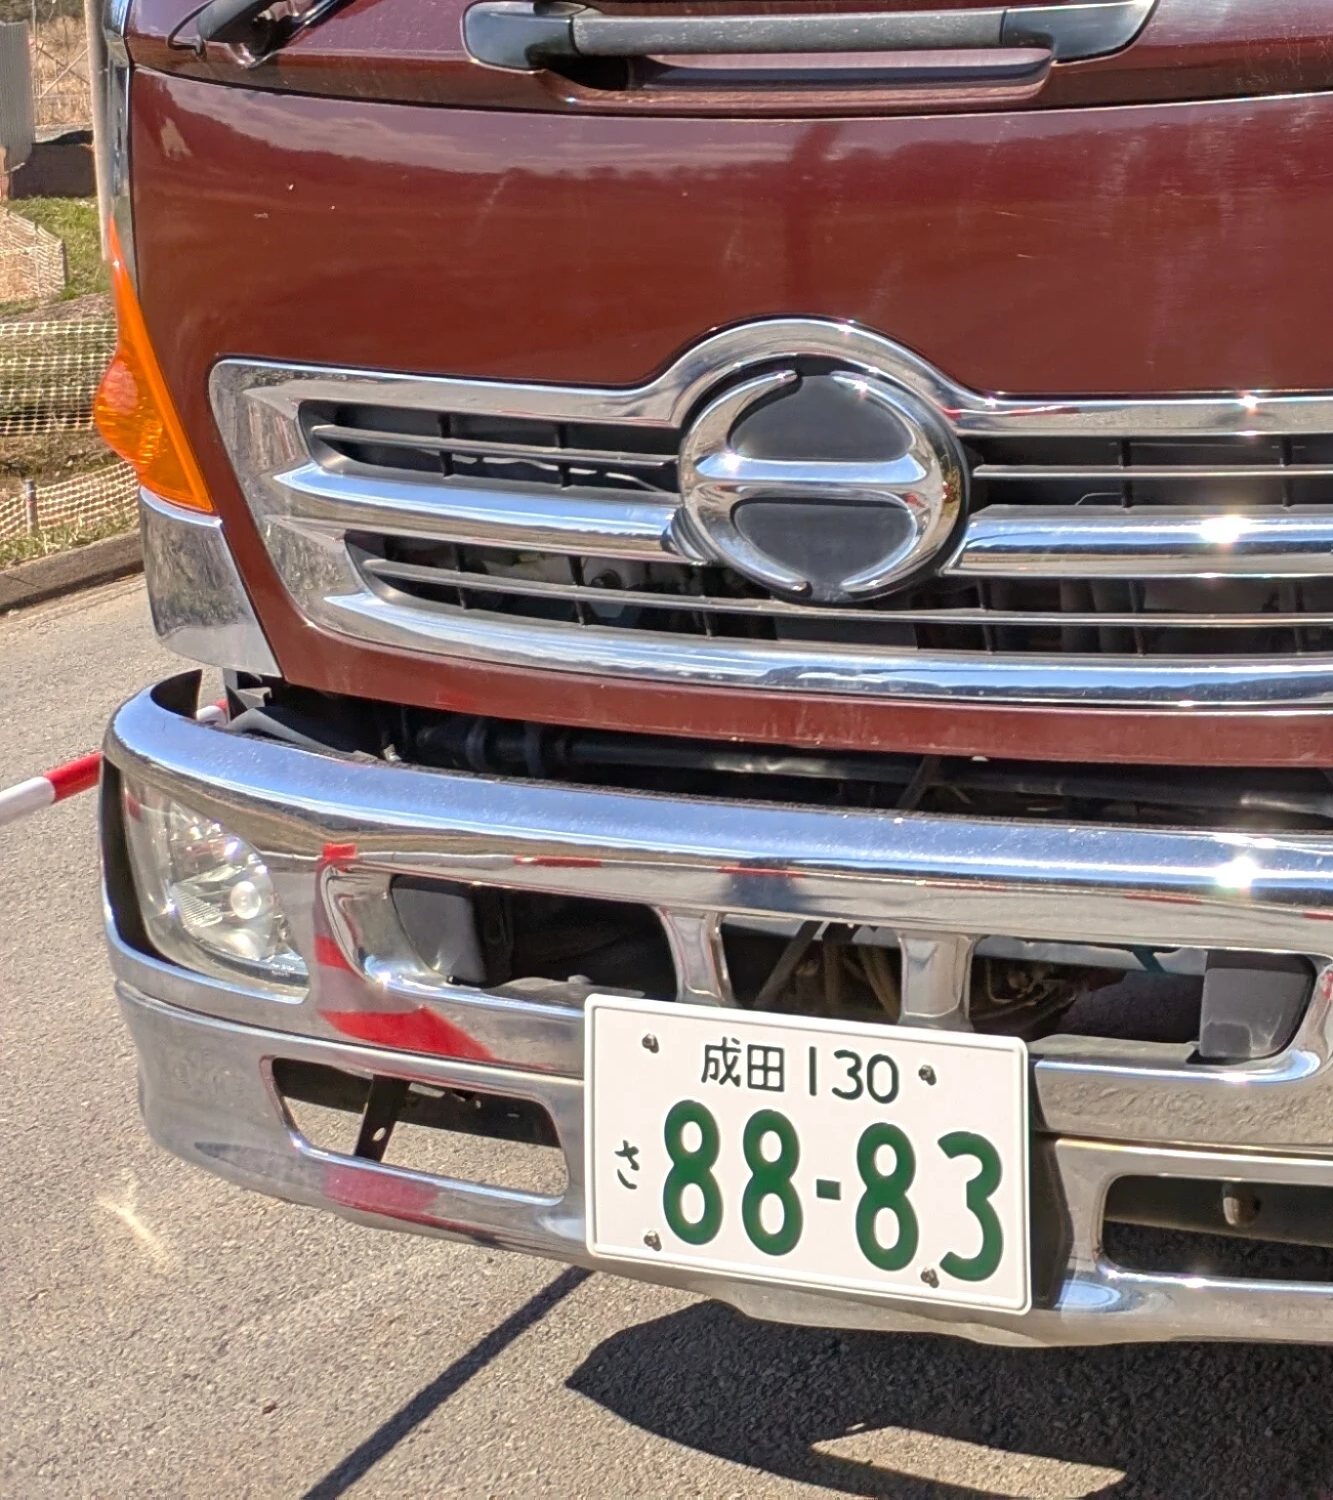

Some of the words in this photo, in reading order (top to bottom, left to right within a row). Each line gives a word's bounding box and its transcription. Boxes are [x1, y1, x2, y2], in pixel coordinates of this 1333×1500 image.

[701, 1037, 785, 1092] 成田
[808, 1046, 900, 1104] 130
[614, 1140, 641, 1189] さ
[662, 1099, 1004, 1282] 88-83
